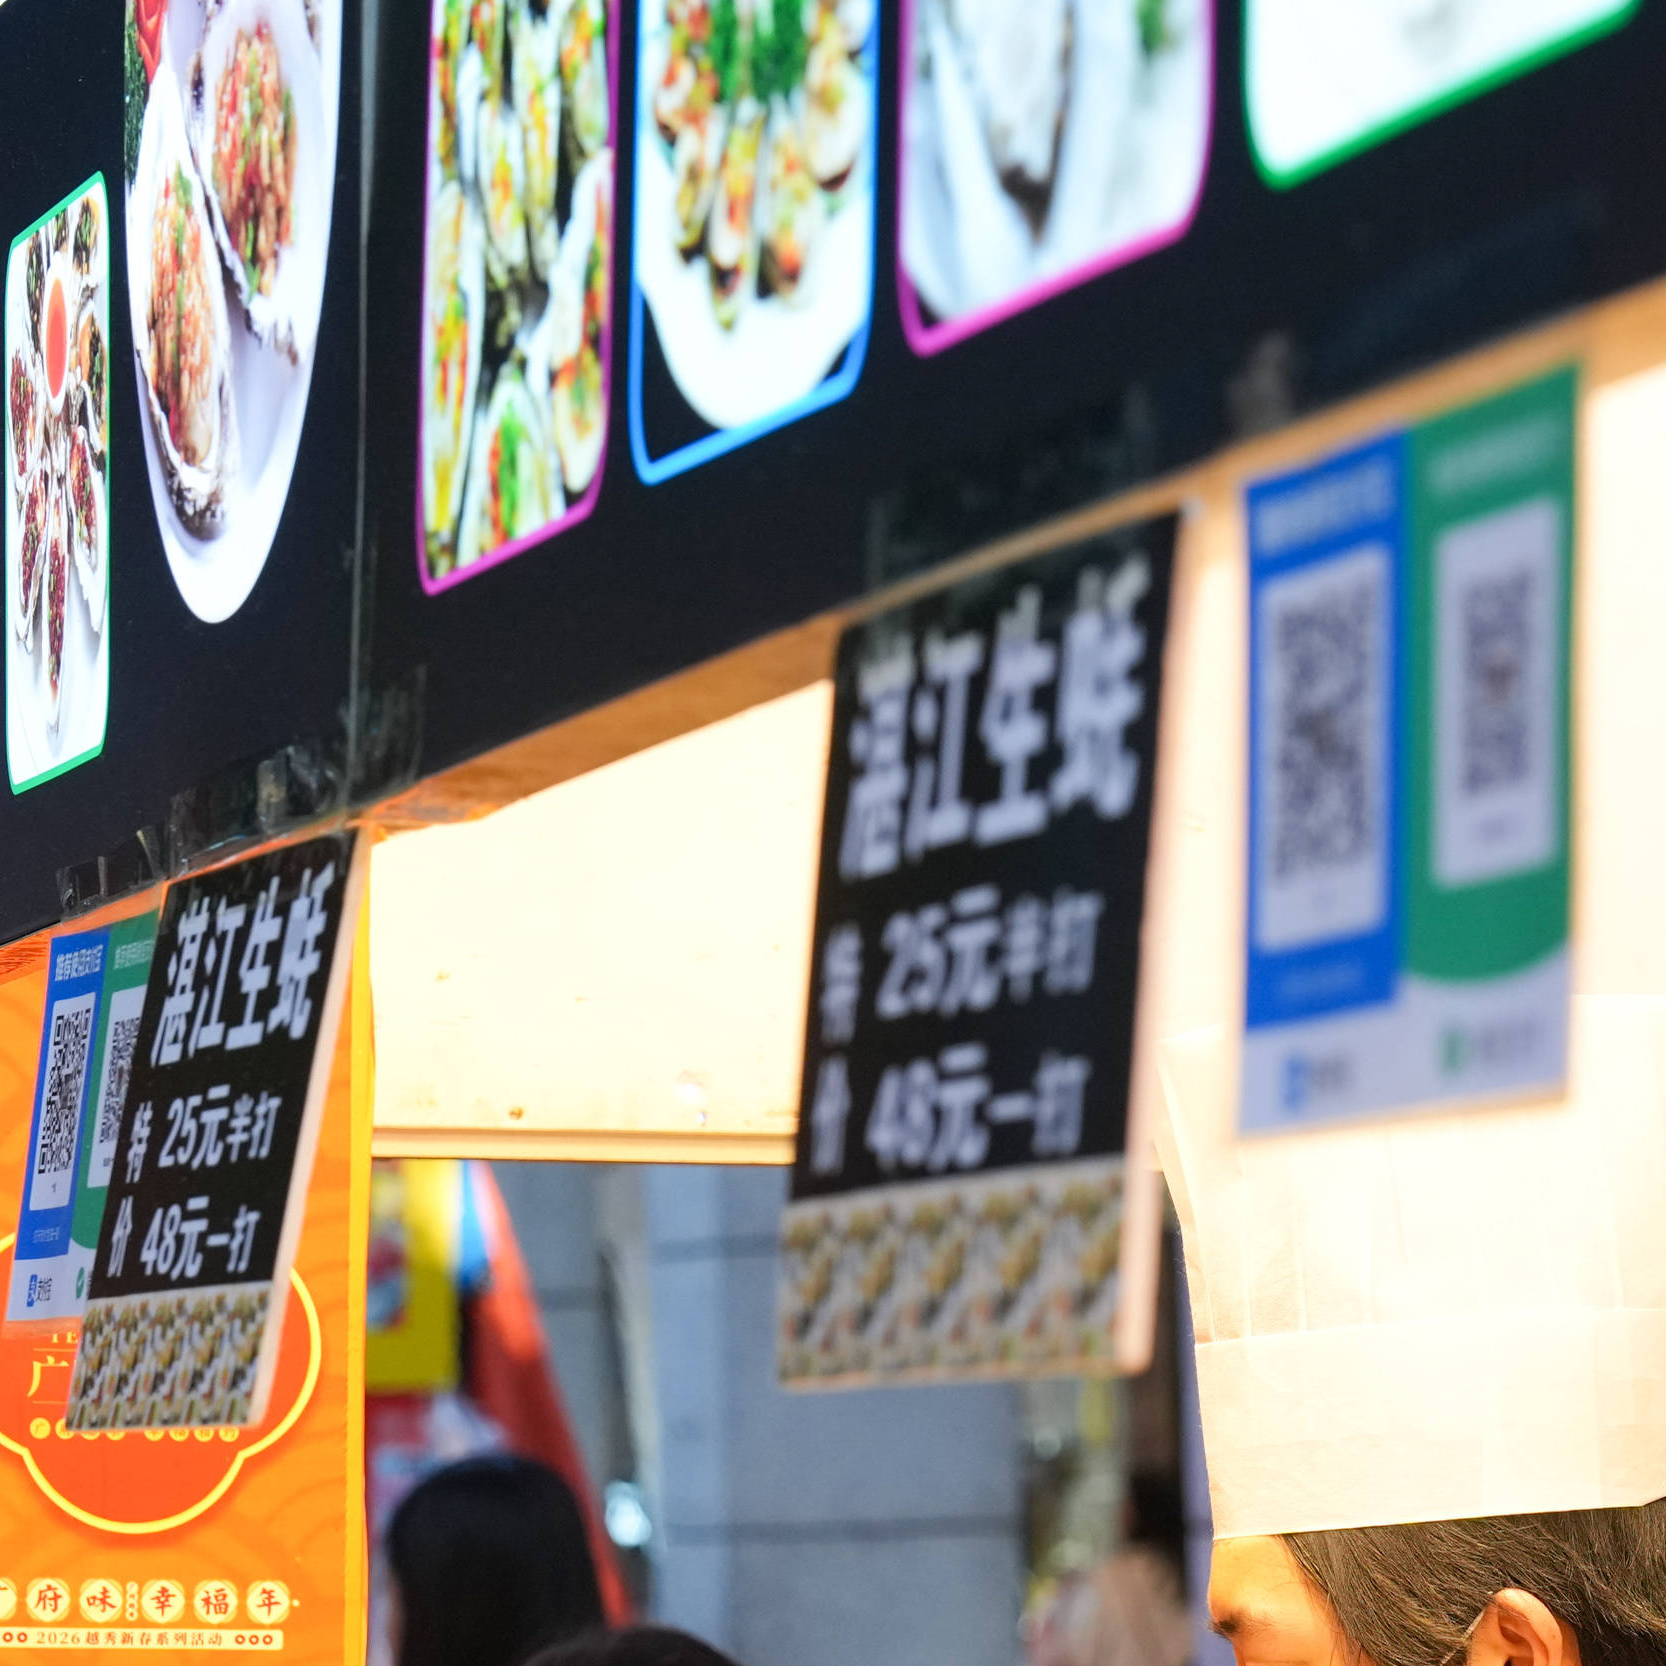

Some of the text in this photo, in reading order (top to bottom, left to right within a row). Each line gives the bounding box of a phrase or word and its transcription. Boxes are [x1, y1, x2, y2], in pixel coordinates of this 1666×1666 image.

[150, 858, 334, 1069] 湛江生蚝
[158, 1083, 281, 1172] 25元半打
[140, 1195, 261, 1279] 48元一打
[36, 1631, 223, 1648] 2026越秀新春系列活动
